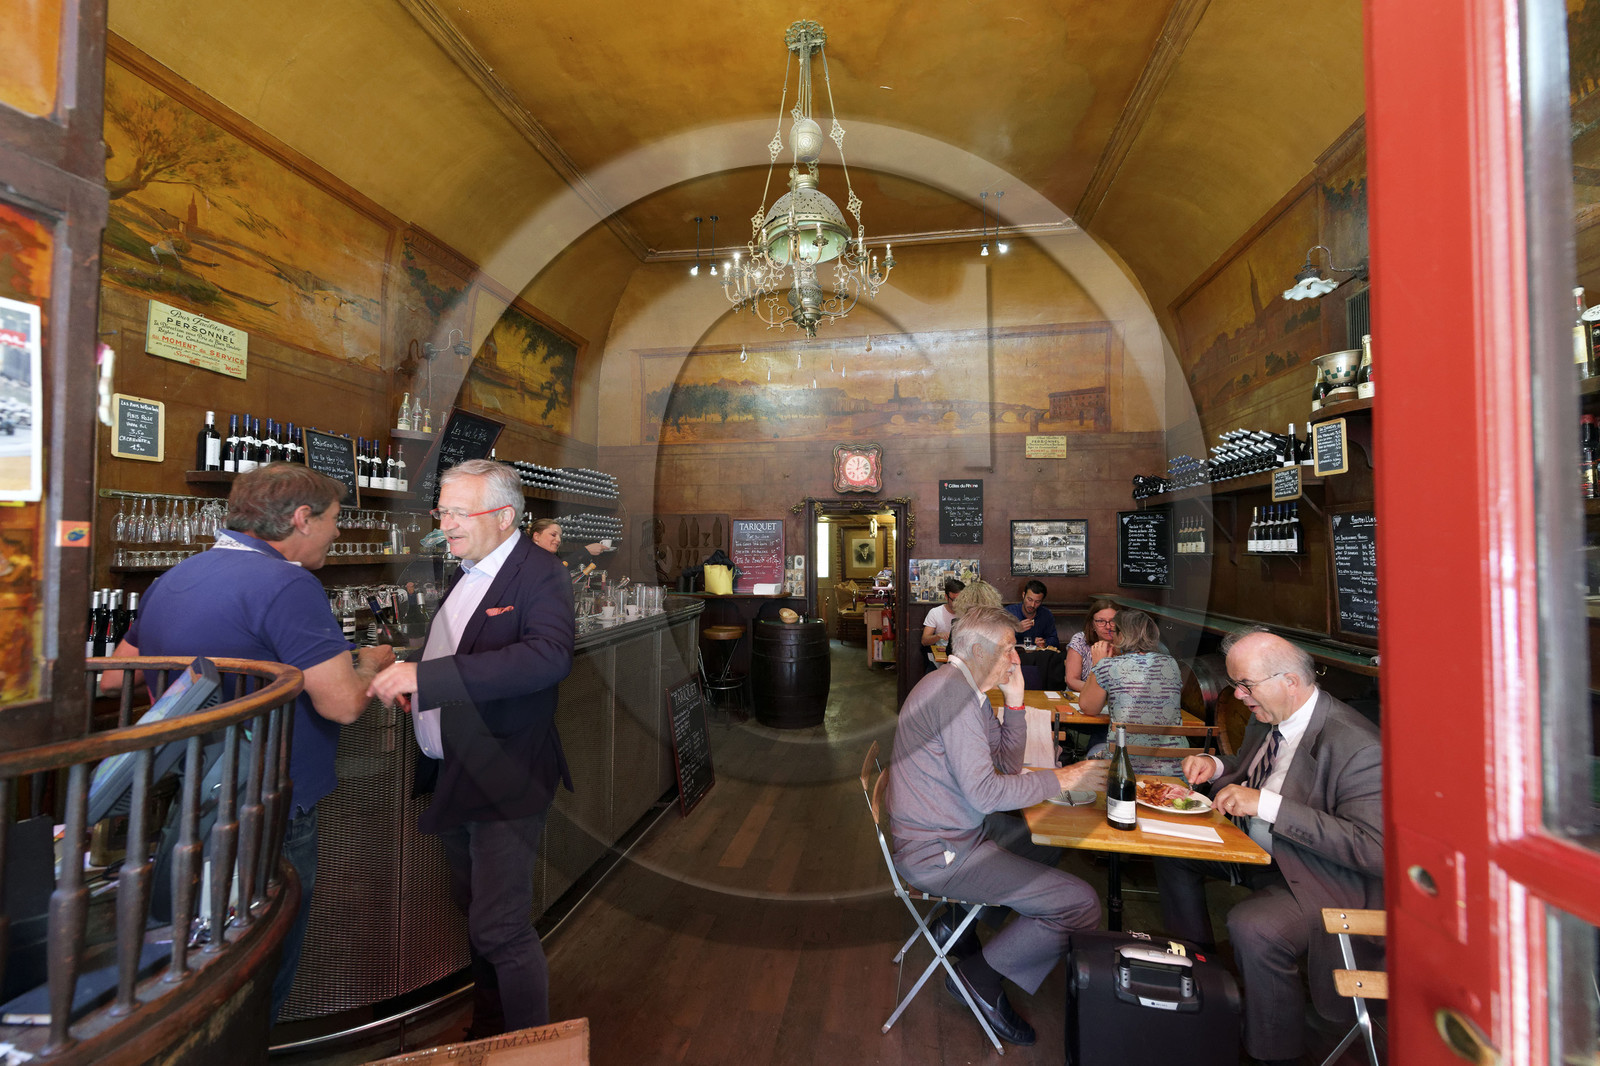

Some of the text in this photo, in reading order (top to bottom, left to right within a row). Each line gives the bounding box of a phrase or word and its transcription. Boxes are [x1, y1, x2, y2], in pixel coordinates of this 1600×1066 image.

[167, 317, 234, 344] PERSONNEL
[170, 309, 190, 321] Pour
[192, 317, 225, 333] Faciliter
[161, 336, 198, 350] MOMENT
[209, 349, 245, 365] SERVICE
[738, 522, 777, 532] TARIQUET
